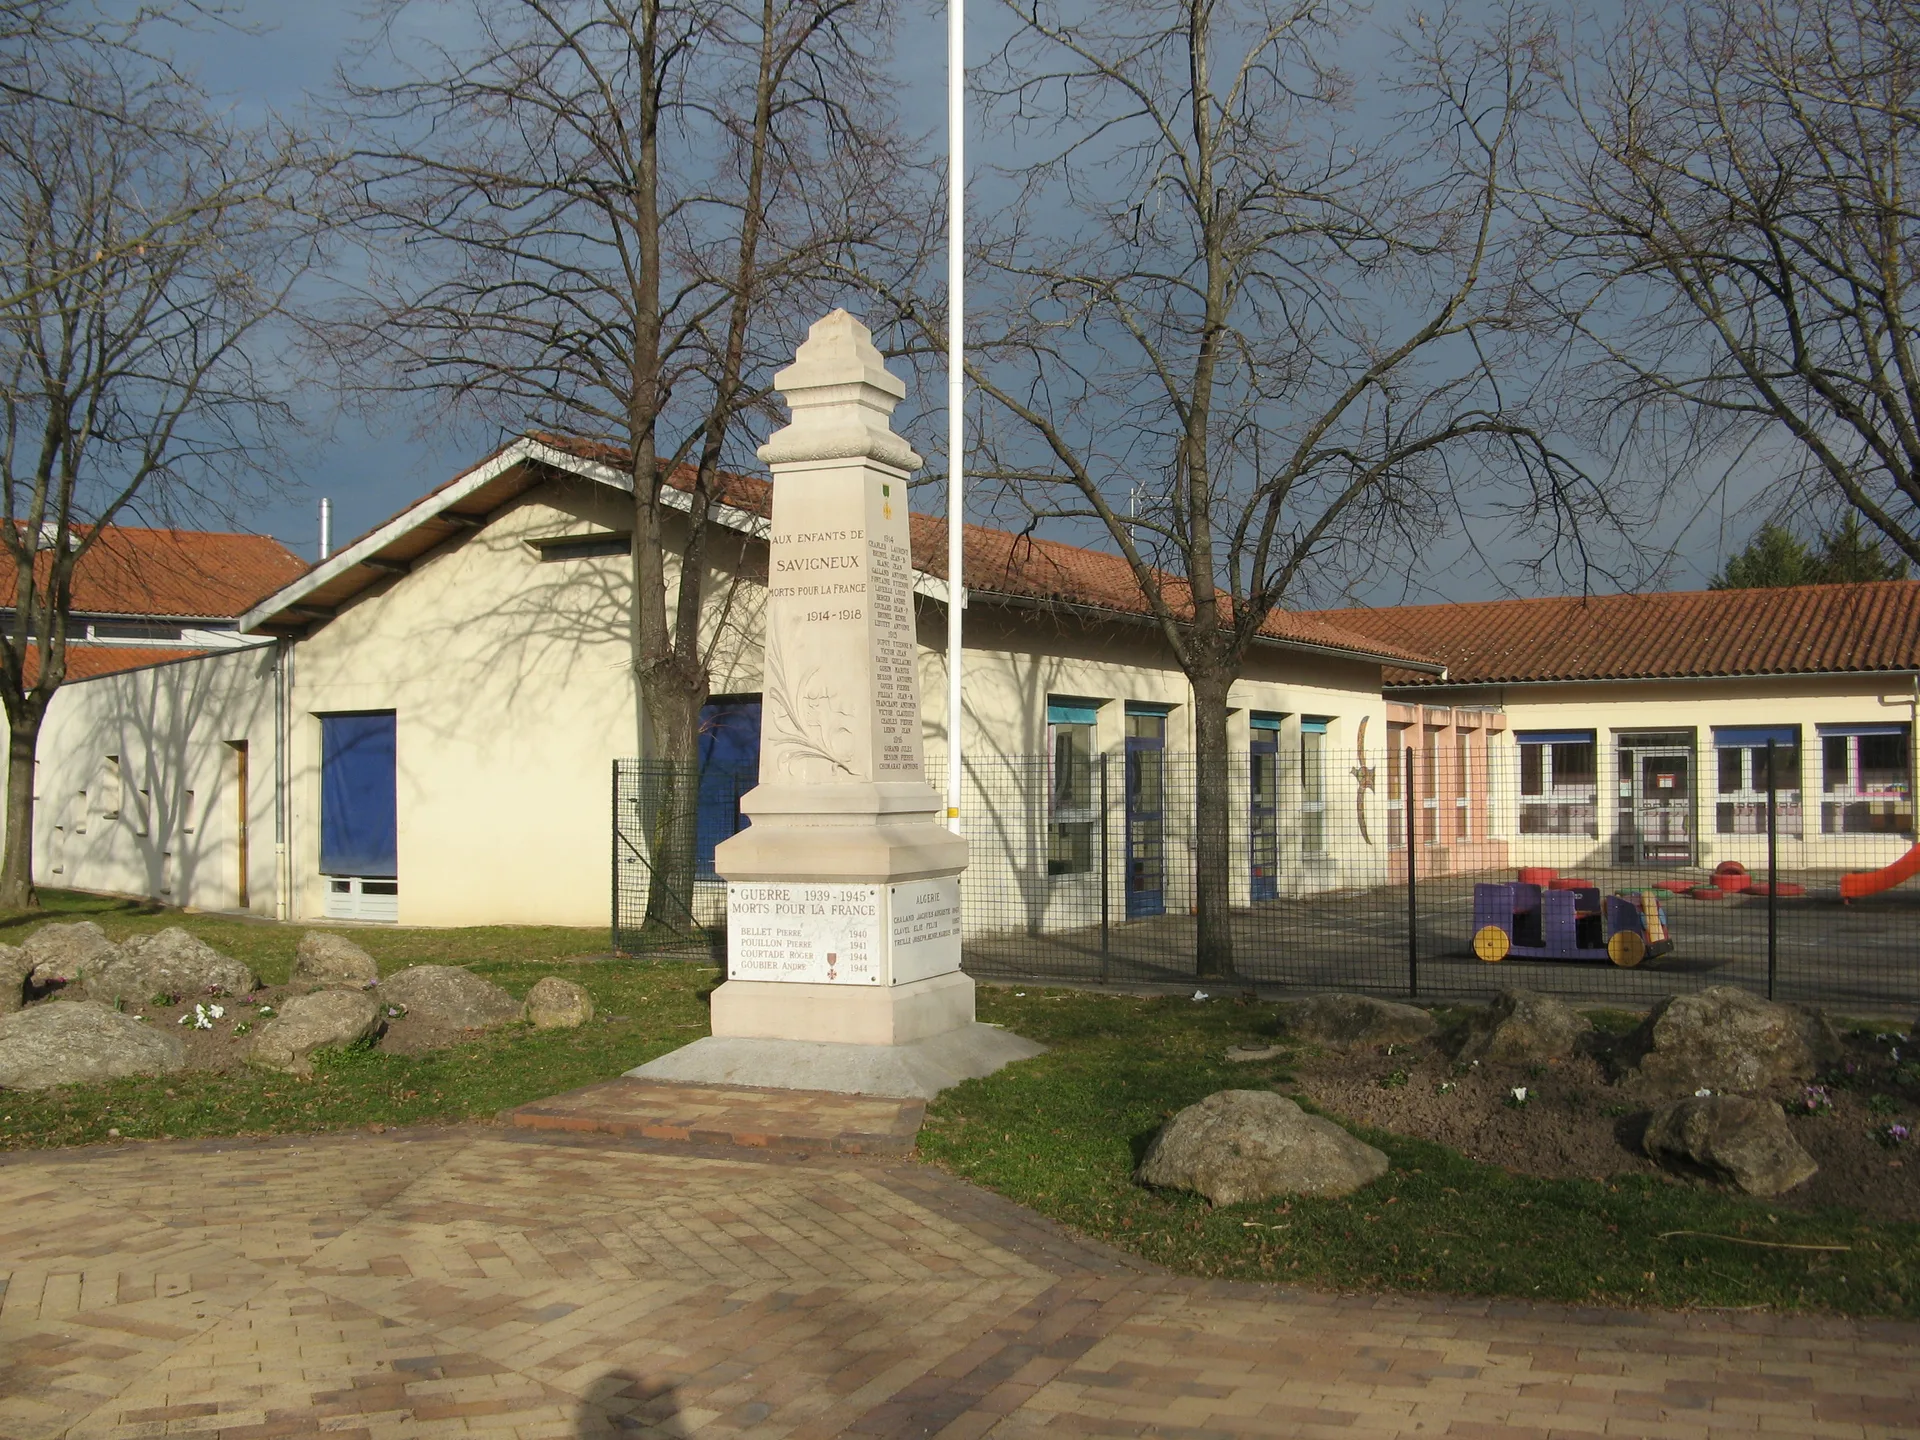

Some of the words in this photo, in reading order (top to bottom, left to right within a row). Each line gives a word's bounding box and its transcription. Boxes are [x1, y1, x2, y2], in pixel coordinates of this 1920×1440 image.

[772, 535, 792, 544] AUX
[798, 531, 846, 542] ENFANTS
[851, 530, 864, 539] DE
[777, 556, 859, 571] SAVIGNEUX
[769, 588, 795, 597] MORTS
[798, 586, 818, 595] POUR
[821, 585, 831, 594] LA
[834, 584, 866, 594] FRANCE
[807, 611, 829, 621] 1914
[839, 609, 862, 620] 1918
[740, 889, 790, 900] GUERRE
[805, 890, 830, 901] 1939
[840, 891, 866, 902] 1945
[916, 893, 940, 904] ALGERIE
[732, 903, 770, 914] MORTS
[776, 904, 805, 914] POUR
[812, 904, 825, 915] LA
[831, 905, 876, 915] FRANCE
[741, 928, 772, 936] BELLET
[850, 930, 867, 938] 1940
[741, 939, 782, 948] POUILLON
[741, 950, 784, 958] COURTADE
[741, 961, 777, 970] GOUBIER
